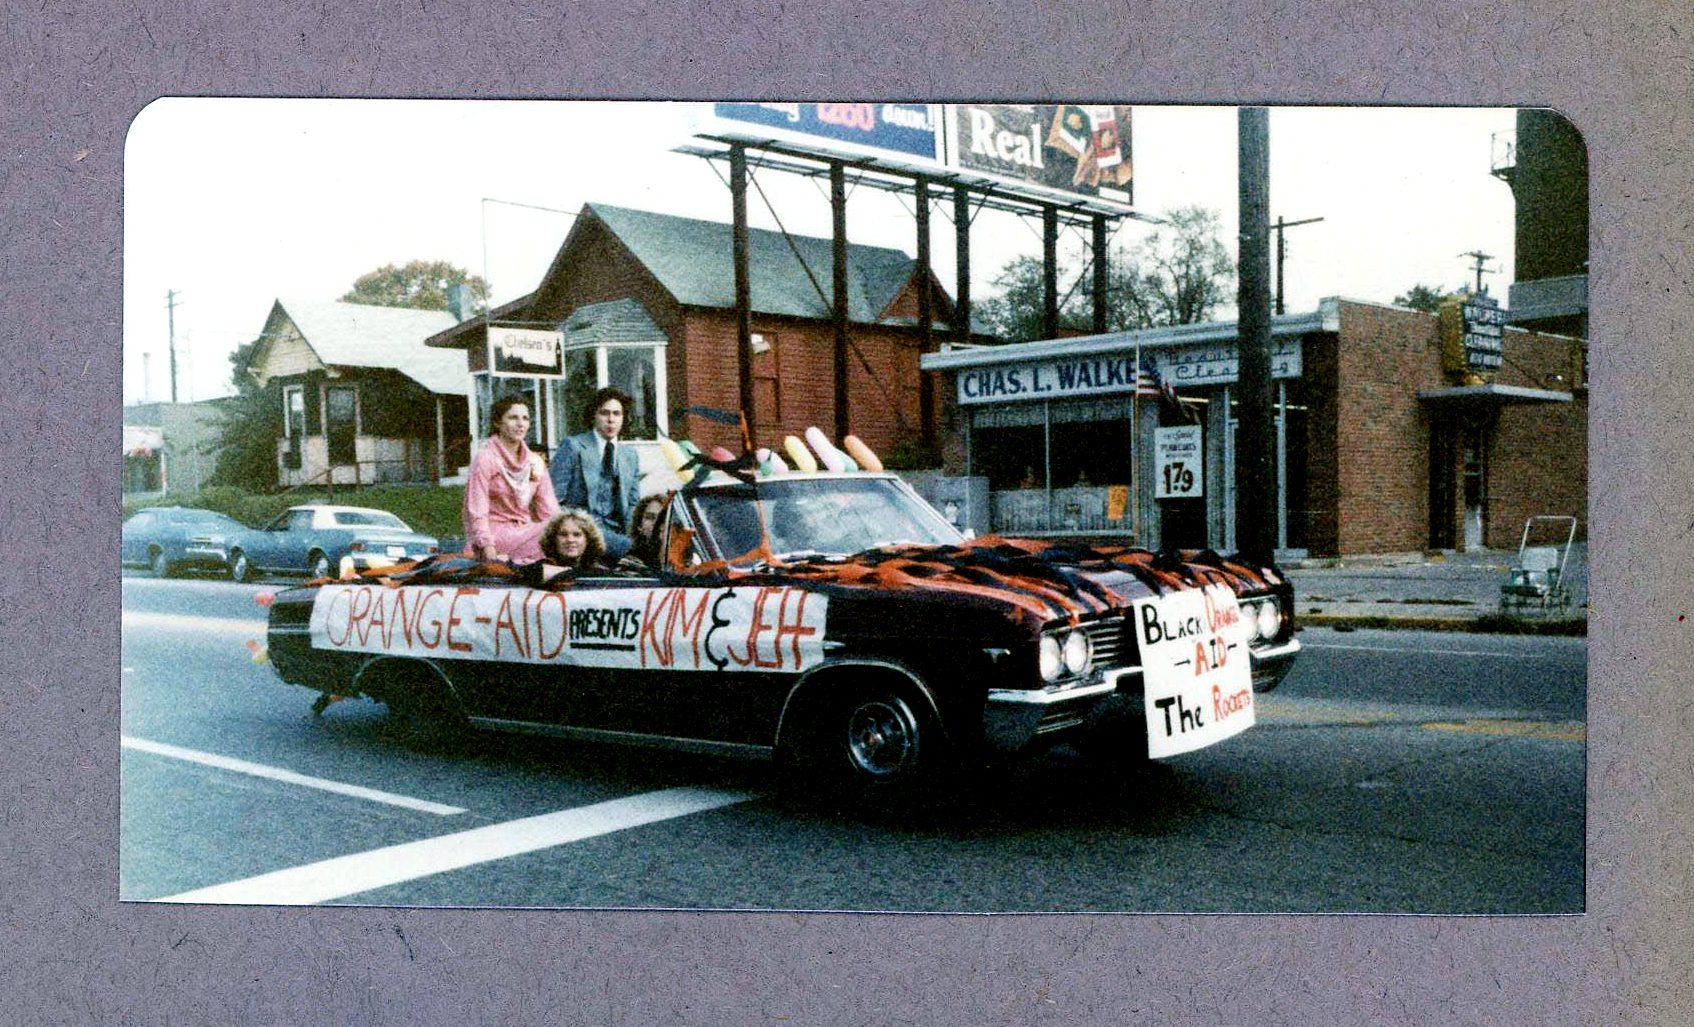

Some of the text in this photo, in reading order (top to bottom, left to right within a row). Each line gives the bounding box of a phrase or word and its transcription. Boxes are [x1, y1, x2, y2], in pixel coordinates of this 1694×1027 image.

[970, 108, 1044, 168] Real
[963, 356, 1137, 398] CHAS. L. WALKE
[569, 608, 640, 640] PRESENTS
[640, 587, 710, 668] KIM
[1154, 694, 1205, 736] The
